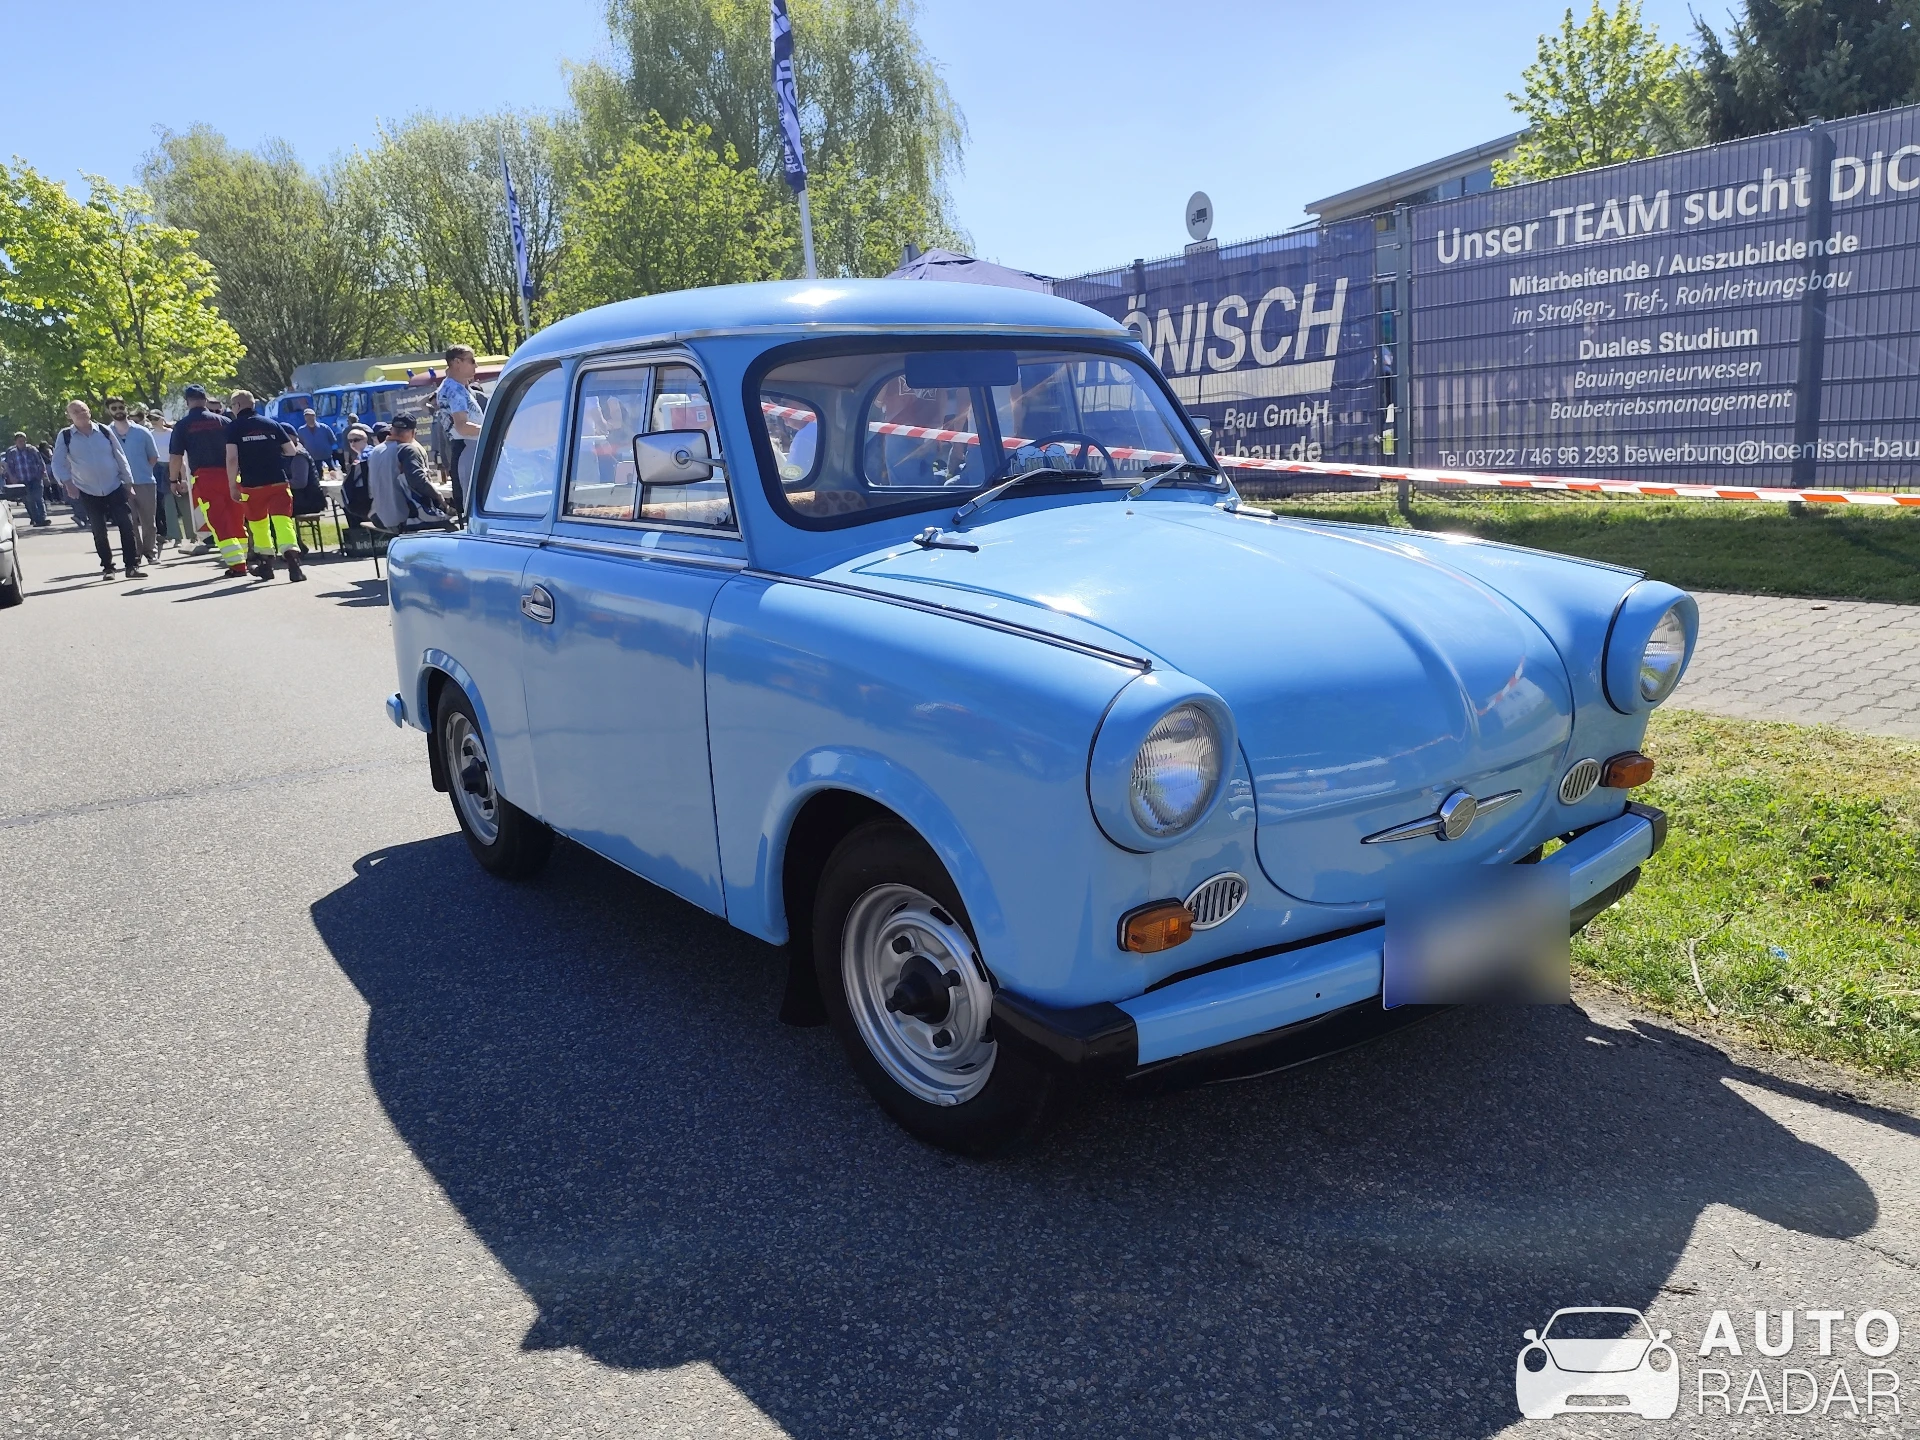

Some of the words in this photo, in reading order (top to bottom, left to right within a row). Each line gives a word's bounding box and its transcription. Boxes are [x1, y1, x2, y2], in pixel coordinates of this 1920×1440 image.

[1437, 222, 1539, 264] Unser
[1550, 190, 1670, 246] TEAM
[1684, 168, 1811, 225] sucht
[1510, 261, 1650, 296] Mitarbeitende
[1669, 231, 1858, 275] Auszubildende
[1512, 307, 1532, 324] im
[1537, 299, 1616, 322] Straßen-,
[1623, 289, 1668, 313] Tief-,
[1676, 269, 1852, 306] Rohrleitungsbau
[1121, 277, 1349, 376] ÖNISCH
[1579, 337, 1651, 359] Duales
[1659, 327, 1758, 352] Studium
[1574, 361, 1762, 390] Bauingenieurwesen
[1224, 407, 1257, 430] Bau
[1263, 400, 1329, 428] GmbH
[1550, 390, 1793, 420] Baubetriebsmanagement
[1530, 447, 1552, 465] 46
[1557, 447, 1579, 465] 96
[1584, 445, 1619, 464] 293
